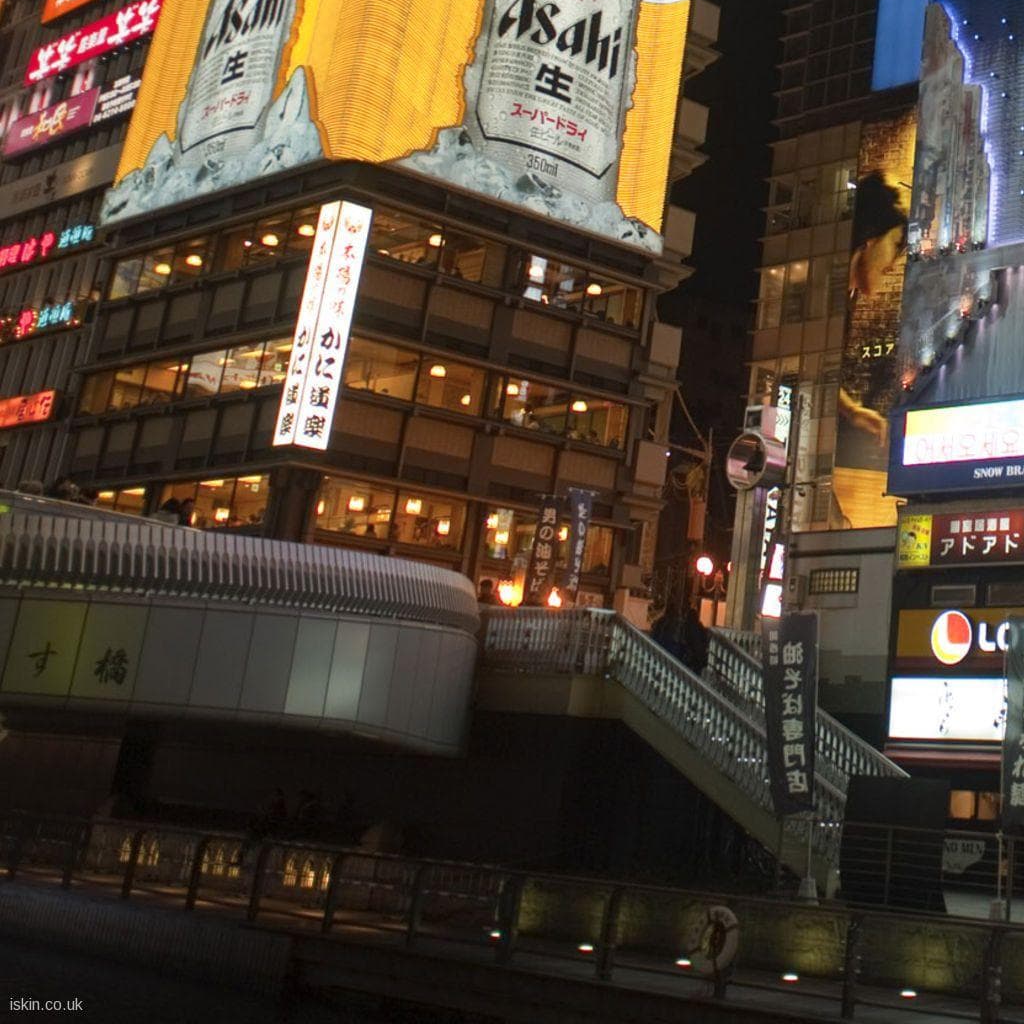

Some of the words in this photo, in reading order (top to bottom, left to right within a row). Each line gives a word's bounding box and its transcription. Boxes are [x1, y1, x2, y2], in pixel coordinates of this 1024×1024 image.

[221, 50, 248, 85] 生
[535, 63, 573, 104] 生
[510, 102, 588, 142] スーパードライ
[526, 154, 558, 175] 350ml
[303, 326, 342, 439] かに道楽
[973, 465, 1005, 479] SNOW
[940, 532, 1020, 556] アドアド
